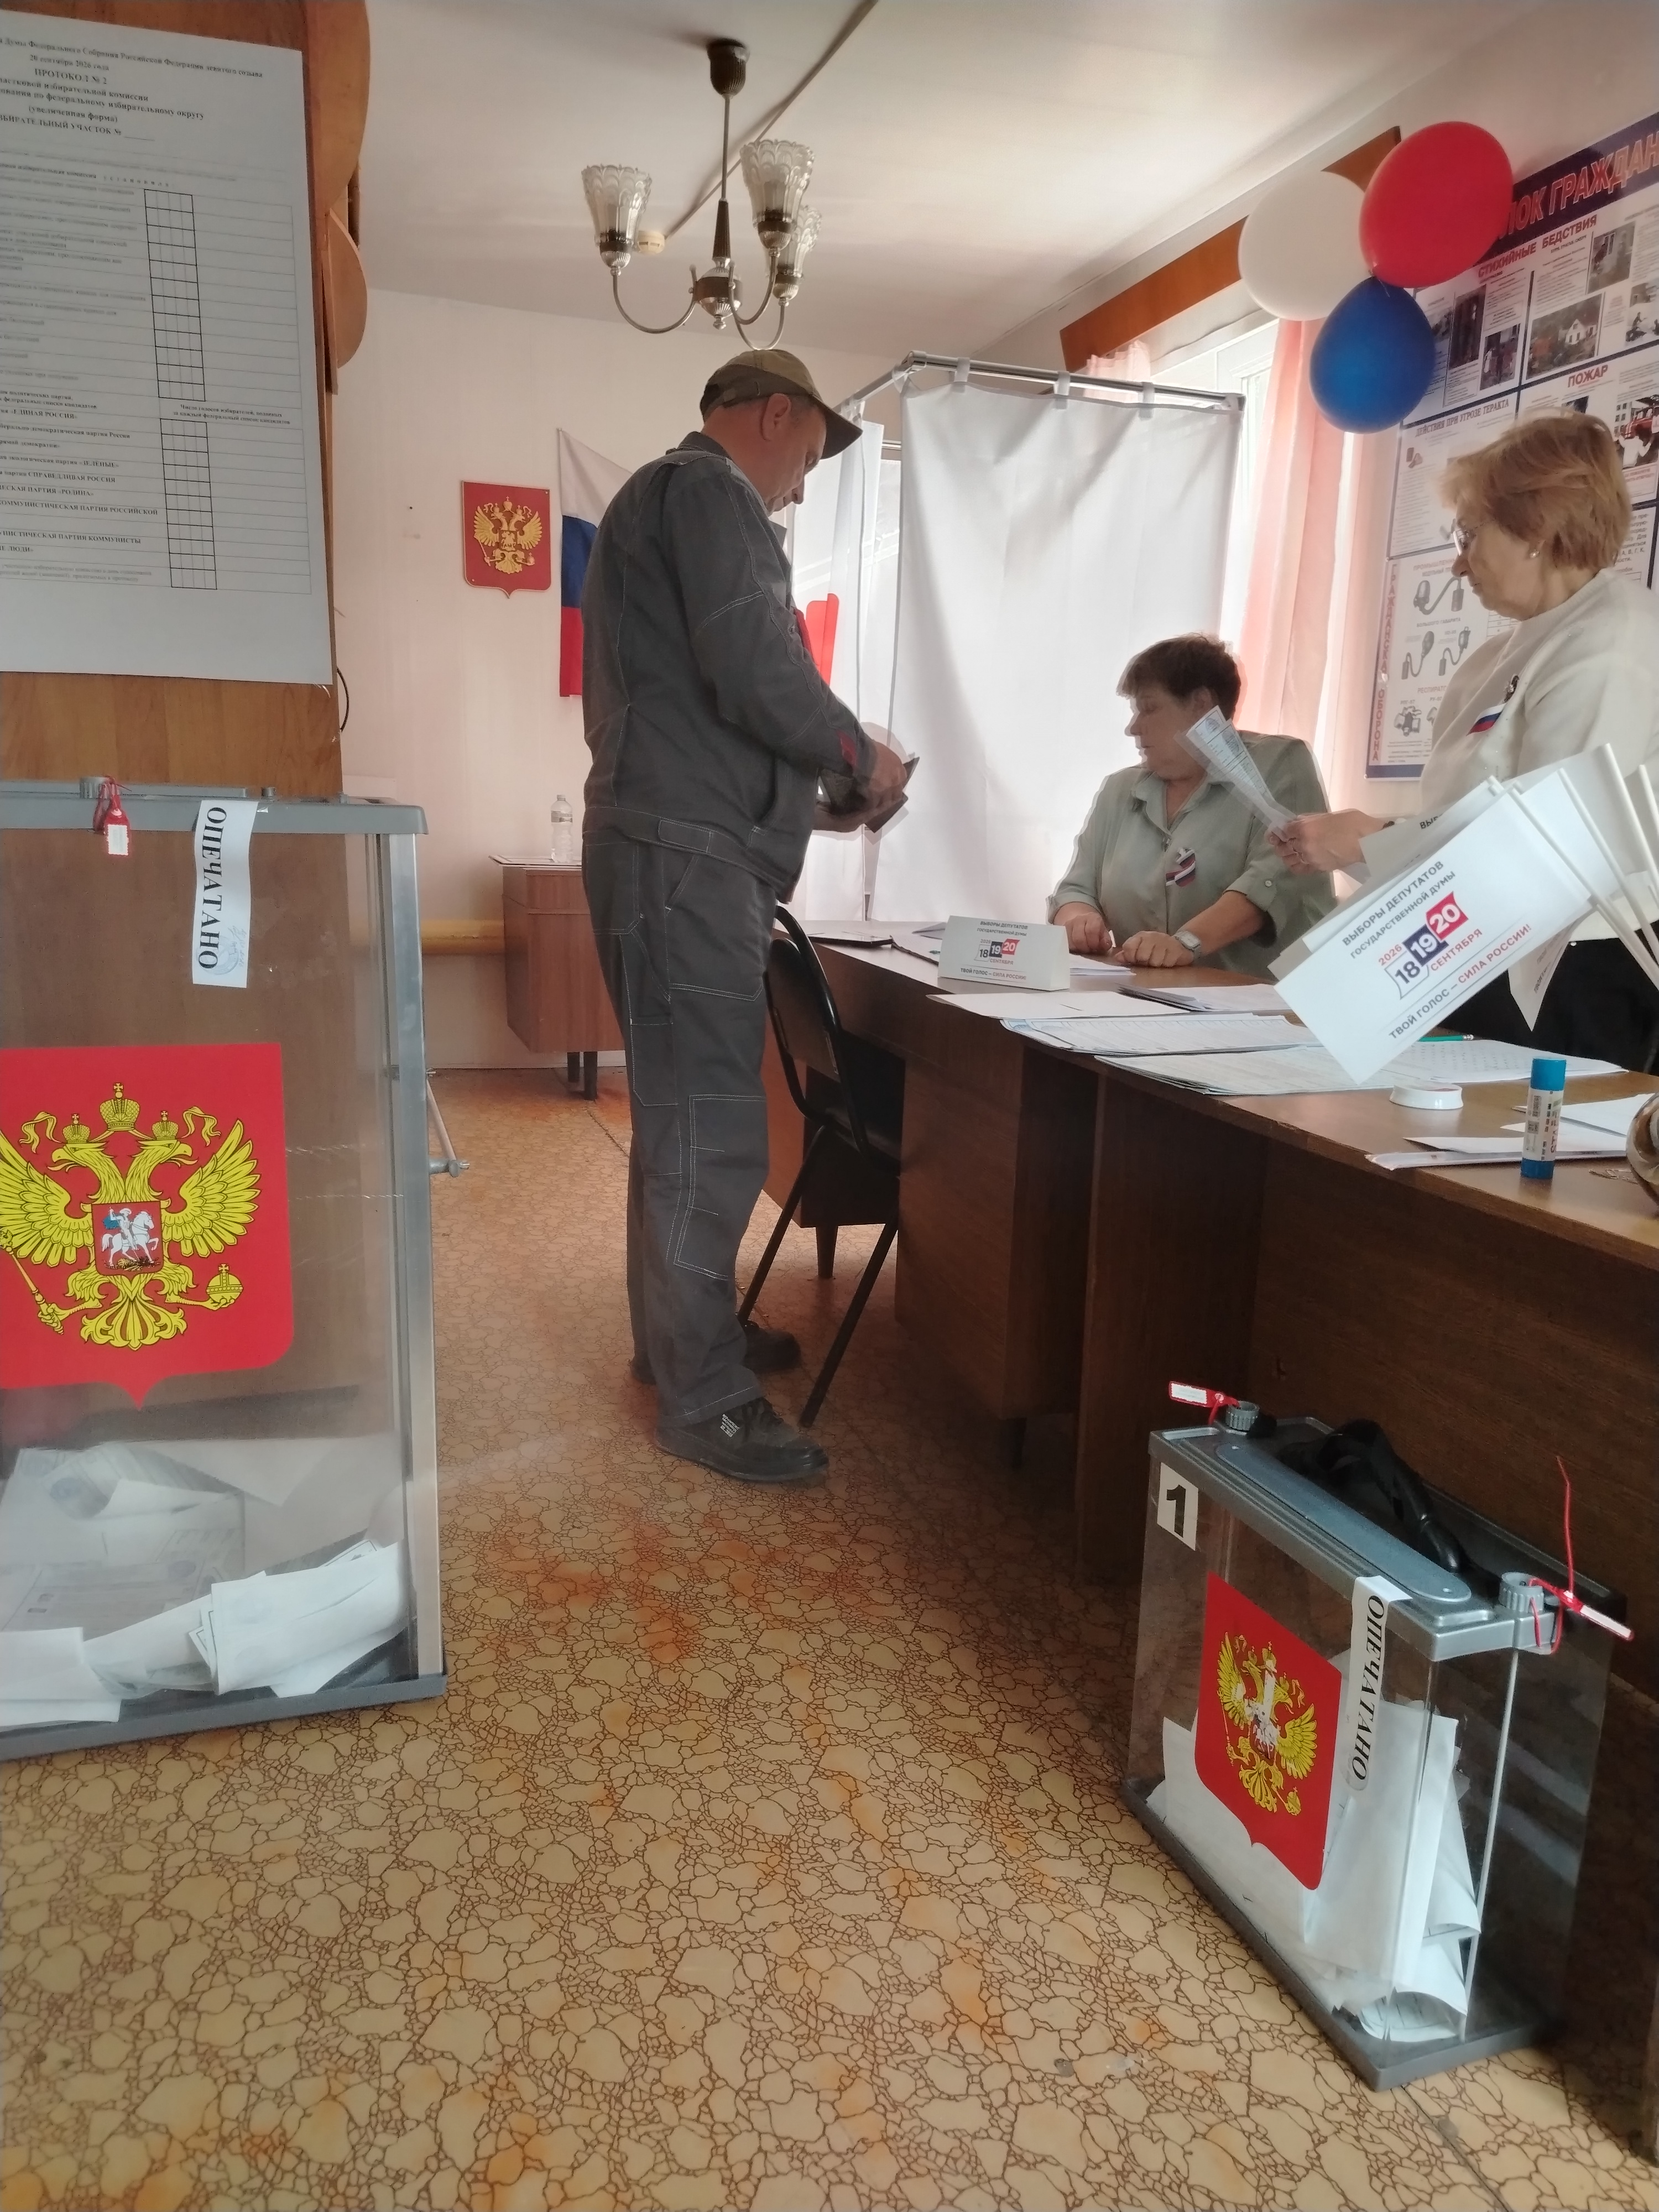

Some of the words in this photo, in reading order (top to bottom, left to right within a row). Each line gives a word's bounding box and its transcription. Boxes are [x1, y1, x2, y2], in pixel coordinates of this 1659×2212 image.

[34, 68, 89, 82] ПРОТОКОЛ
[108, 91, 149, 102] комиссии
[177, 109, 204, 121] округу
[1478, 242, 1537, 278] СТИХИЙНЫЕ
[1542, 214, 1597, 249] БЕДСТВИЯ
[1568, 364, 1608, 388] ПОЖАР
[1446, 416, 1458, 427] ПРИ
[1459, 408, 1481, 422] УГРОЗЕ
[1483, 399, 1509, 415] ТЕРАКТА
[109, 507, 158, 515] РОССИЙСКОЙ
[88, 536, 141, 544] КОММУНИСТЫ
[1373, 688, 1385, 761] ОБОРОНА
[198, 807, 227, 969] ОПЕЧАТАНО
[1342, 907, 1387, 946] ВЫБОРЫ
[1385, 860, 1444, 912] ДЕПУТАТОВ
[1350, 891, 1430, 959] ГОСУДАРСТВЕННОЙ
[1430, 870, 1455, 896] ДУМЫ
[979, 949, 989, 958] 18
[991, 945, 1001, 954] 19
[1003, 942, 1015, 952] 20
[1378, 943, 1402, 966] 2026
[1395, 961, 1421, 984] 18
[1411, 934, 1437, 958] 19
[1430, 904, 1460, 933] 20
[1430, 928, 1483, 972] СЕНТЯБРЯ
[1389, 1016, 1417, 1040] ТВОЙ
[1416, 988, 1450, 1018] ГОЛОС
[1458, 961, 1487, 984] СИЛА
[1486, 924, 1532, 962] РОССИИ!
[1166, 1484, 1186, 1538] 1
[1352, 1595, 1385, 1780] ОПЕЧАТАНО
